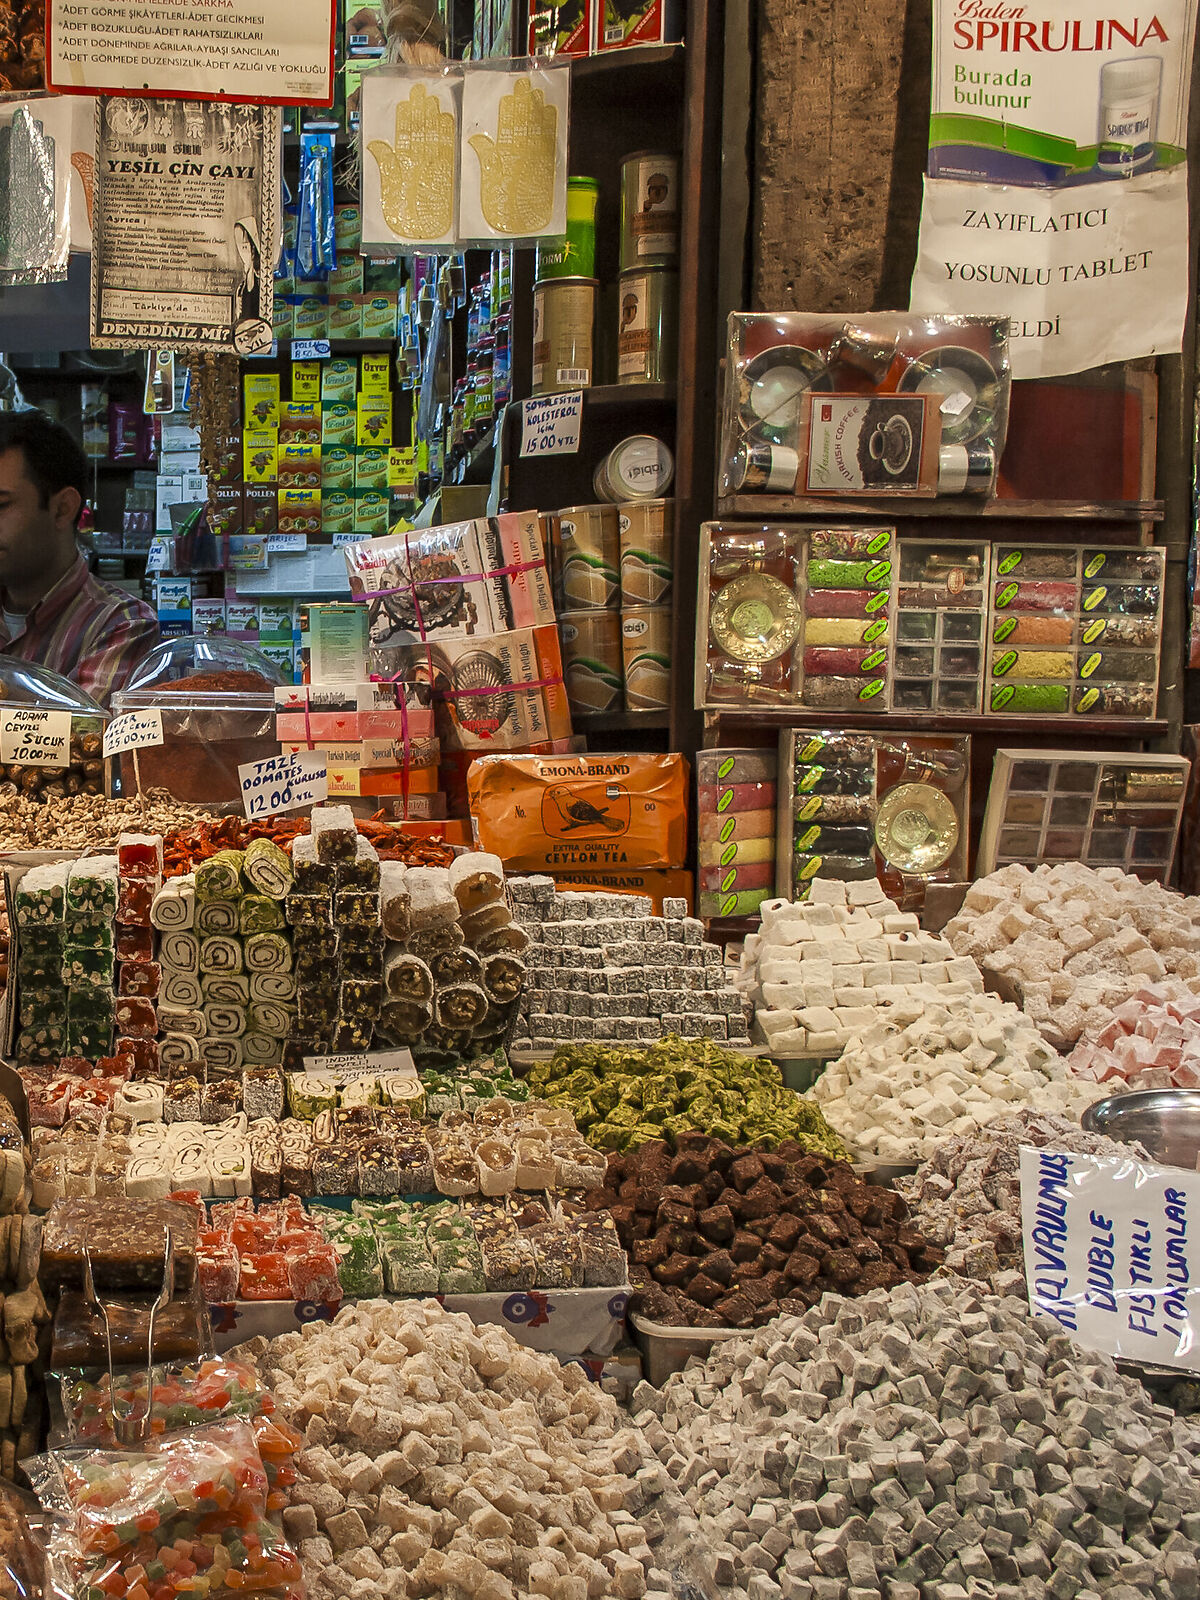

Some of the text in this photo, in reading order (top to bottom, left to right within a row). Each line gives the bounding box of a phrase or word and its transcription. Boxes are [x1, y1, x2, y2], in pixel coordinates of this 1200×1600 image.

[953, 16, 1171, 52] SPIRULINA
[266, 64, 276, 73] VE
[280, 64, 327, 74] YOKLUĞU
[954, 64, 1033, 88] Burada
[954, 86, 1033, 109] bulunur
[107, 158, 256, 180] YEŞİL ÇİN ÇAYI
[106, 215, 140, 224] Ayrıca
[962, 207, 1109, 235] ZAYIFLATICI
[944, 250, 1154, 286] YOSUNLU TABLET
[102, 321, 198, 340] DENEDİNİZ
[201, 325, 231, 342] Mİ?
[1008, 314, 1061, 338] ELDİ
[527, 408, 577, 426] KOLESTEROL
[834, 405, 860, 482] TURKISH COFFEE
[216, 489, 241, 498] OLLEN
[246, 489, 276, 498] POLLEN
[526, 522, 549, 612] Special Delight
[520, 642, 541, 732] Special Delight
[13, 711, 49, 722] ADANA
[22, 732, 65, 747] SUCUK
[10, 747, 43, 760] 10.00
[327, 750, 361, 762] Turkish Delight
[372, 748, 392, 759] Special
[253, 752, 299, 775] TAZE
[540, 764, 630, 777] EMONA-BRAND
[243, 765, 303, 791] DOMATES
[514, 805, 527, 819] No.
[584, 843, 620, 851] QUALITY
[545, 851, 628, 864] CEYLON TEA
[555, 875, 644, 888] EMONA-BRAND
[314, 1054, 367, 1065] FINDIKLI
[1031, 1152, 1079, 1332] KAVRULMUŞ
[1085, 1209, 1119, 1313] DUBLE
[1128, 1218, 1158, 1337] FISTIKLI
